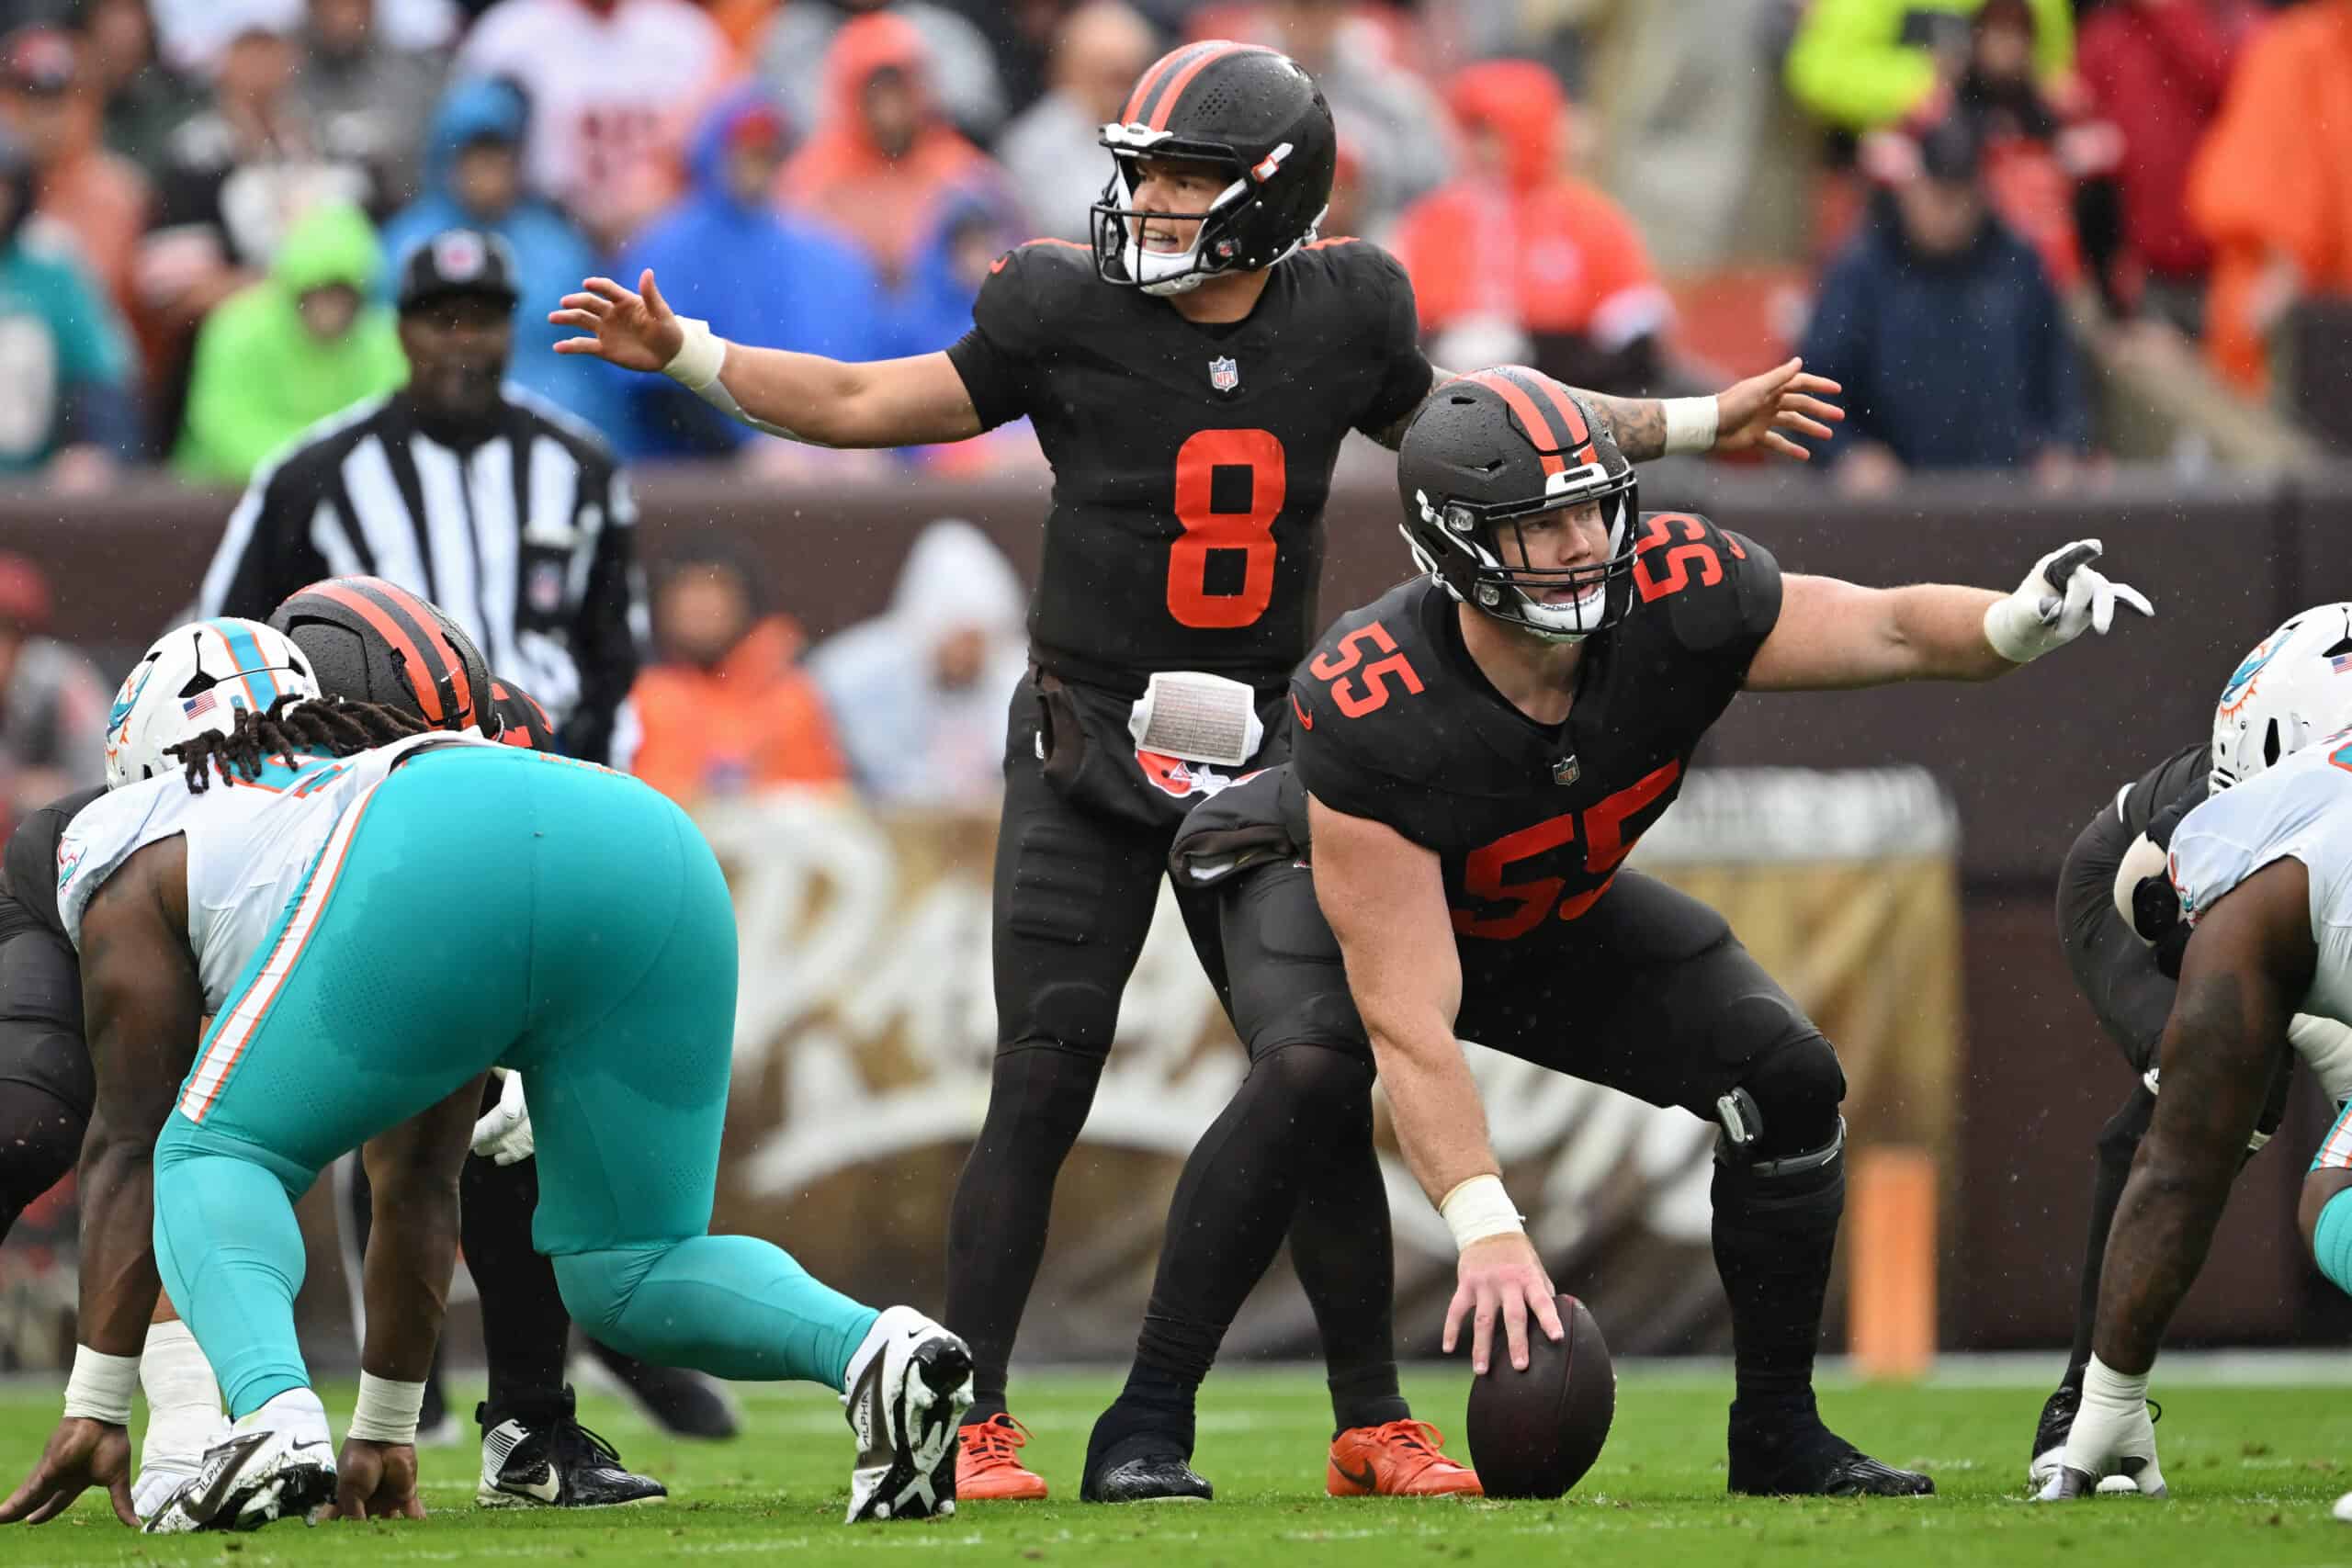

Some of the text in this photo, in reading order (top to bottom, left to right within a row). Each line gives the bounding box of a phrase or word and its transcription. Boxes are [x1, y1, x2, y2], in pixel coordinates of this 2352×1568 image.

[1167, 428, 1286, 628] 8
[1633, 513, 1724, 604] 55
[1309, 620, 1425, 718] 55
[1451, 757, 1679, 940] 55
